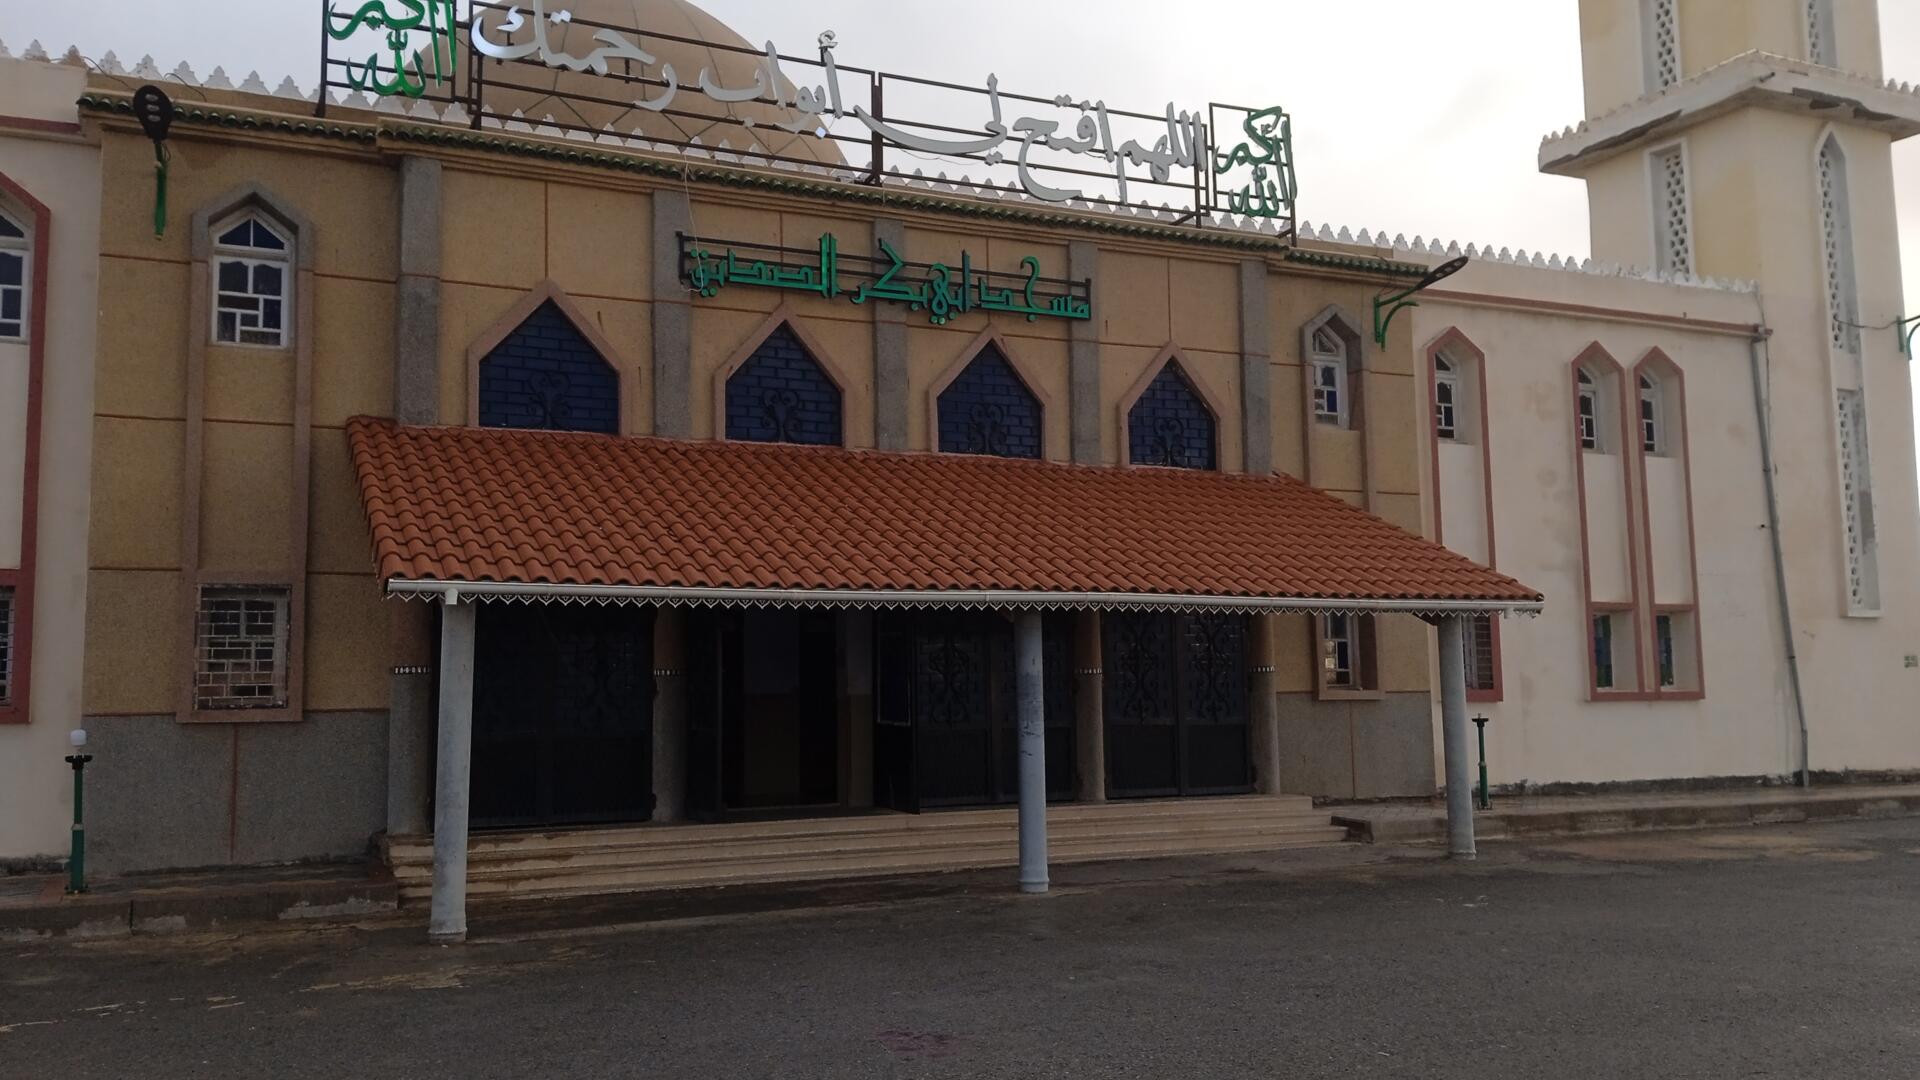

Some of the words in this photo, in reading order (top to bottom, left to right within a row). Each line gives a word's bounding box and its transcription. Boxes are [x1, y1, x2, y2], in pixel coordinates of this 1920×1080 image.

[471, 0, 678, 111] رحمتك
[853, 73, 1007, 165] لي
[1013, 94, 1114, 202] افتح
[1117, 101, 1207, 205] اللهم
[1228, 134, 1290, 217] الله
[686, 232, 842, 298] الصديق
[850, 238, 929, 312] بكر
[978, 256, 1090, 321] مسجد
